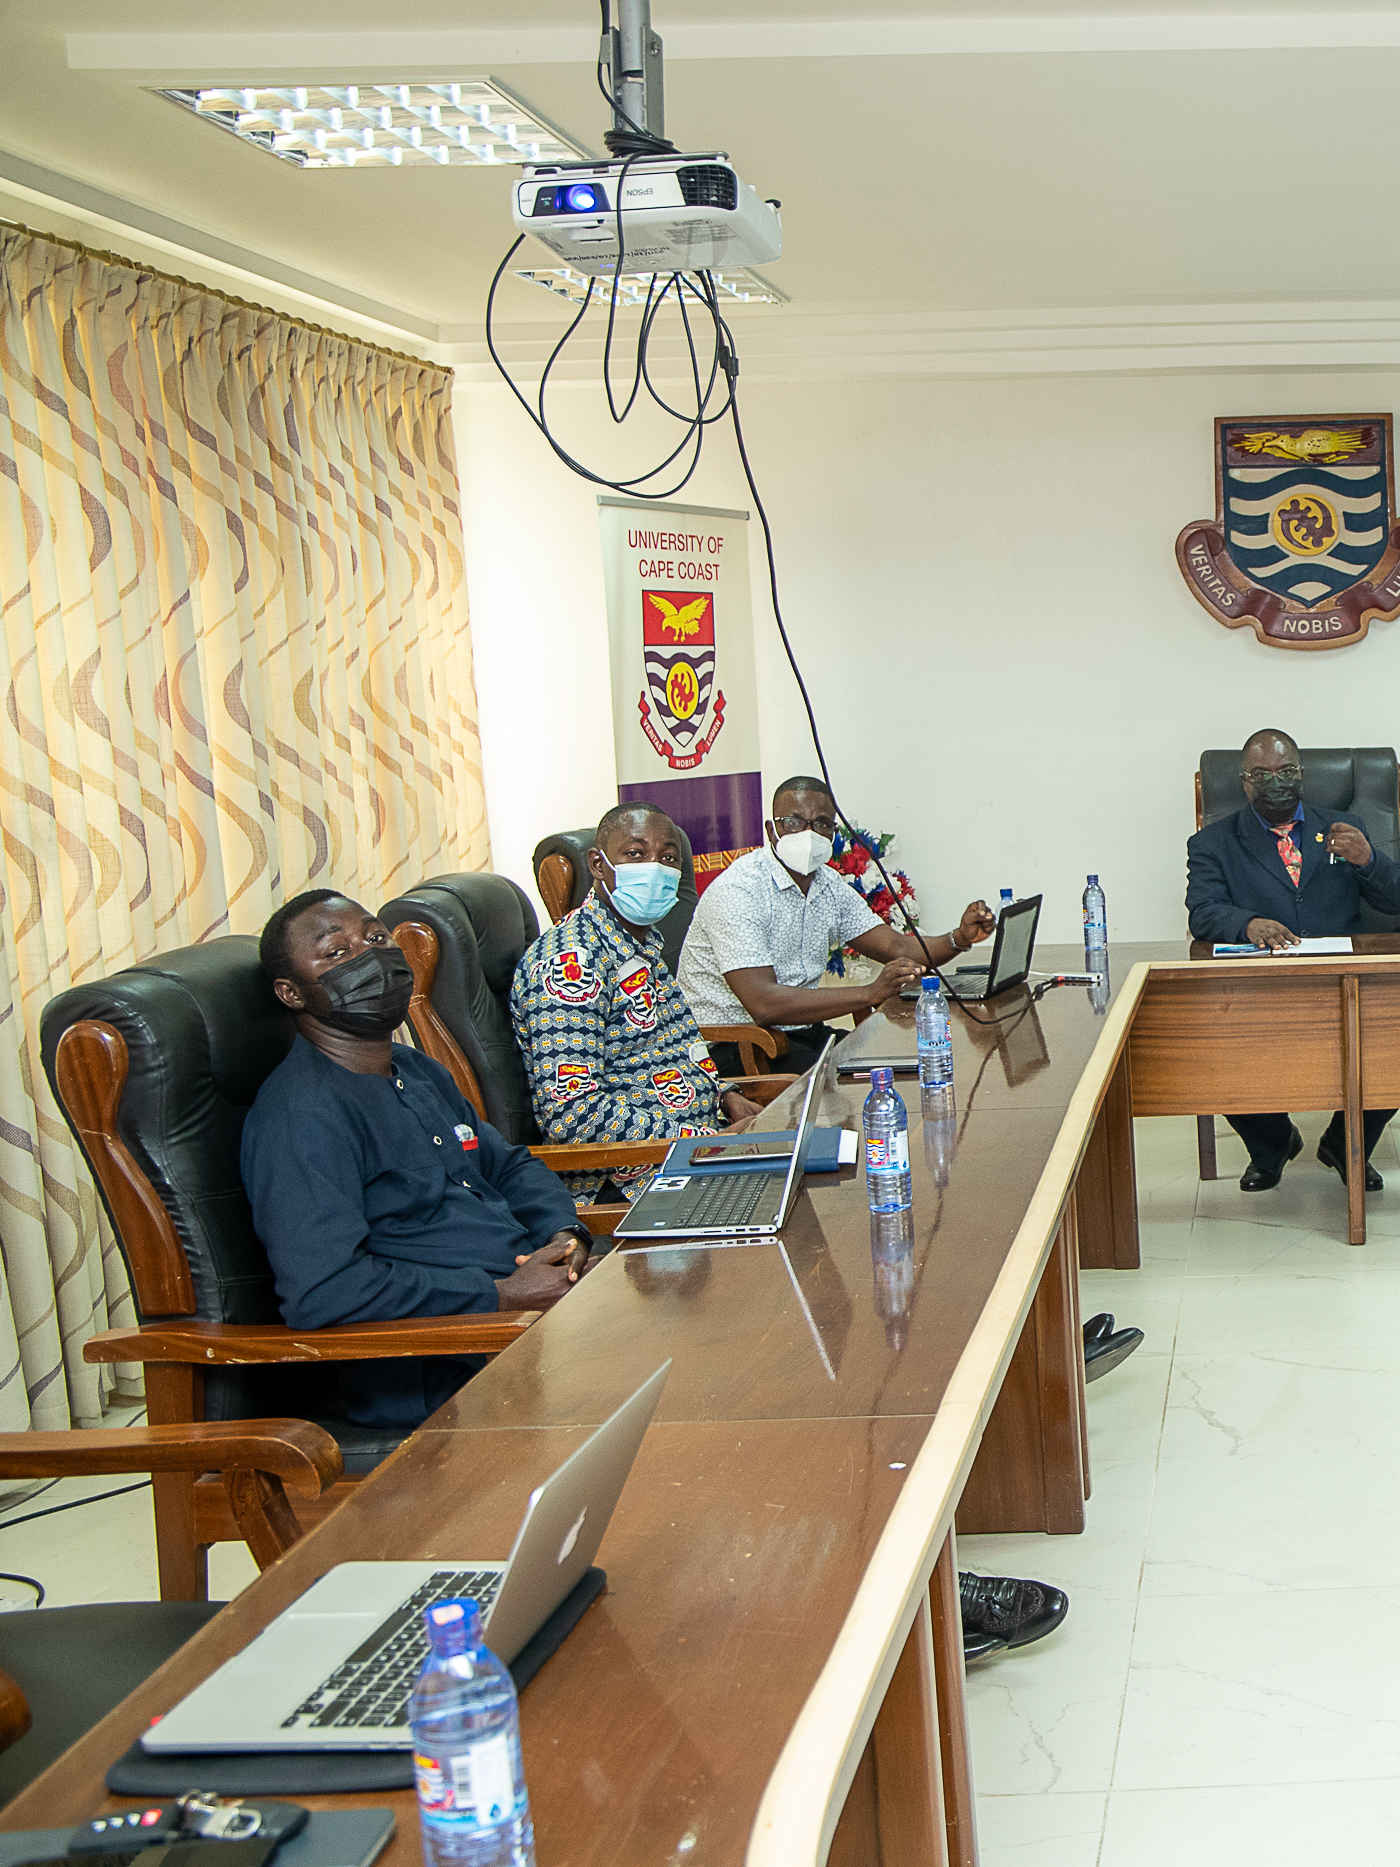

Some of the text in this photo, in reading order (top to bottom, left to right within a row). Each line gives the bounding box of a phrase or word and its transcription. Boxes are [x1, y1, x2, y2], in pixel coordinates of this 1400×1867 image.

[628, 529, 724, 554] UNIVERSITY OF
[638, 559, 720, 581] CAPE COAST
[1189, 543, 1236, 607] VERITAS
[1282, 615, 1343, 635] NOBIS
[675, 758, 695, 768] NOBIS
